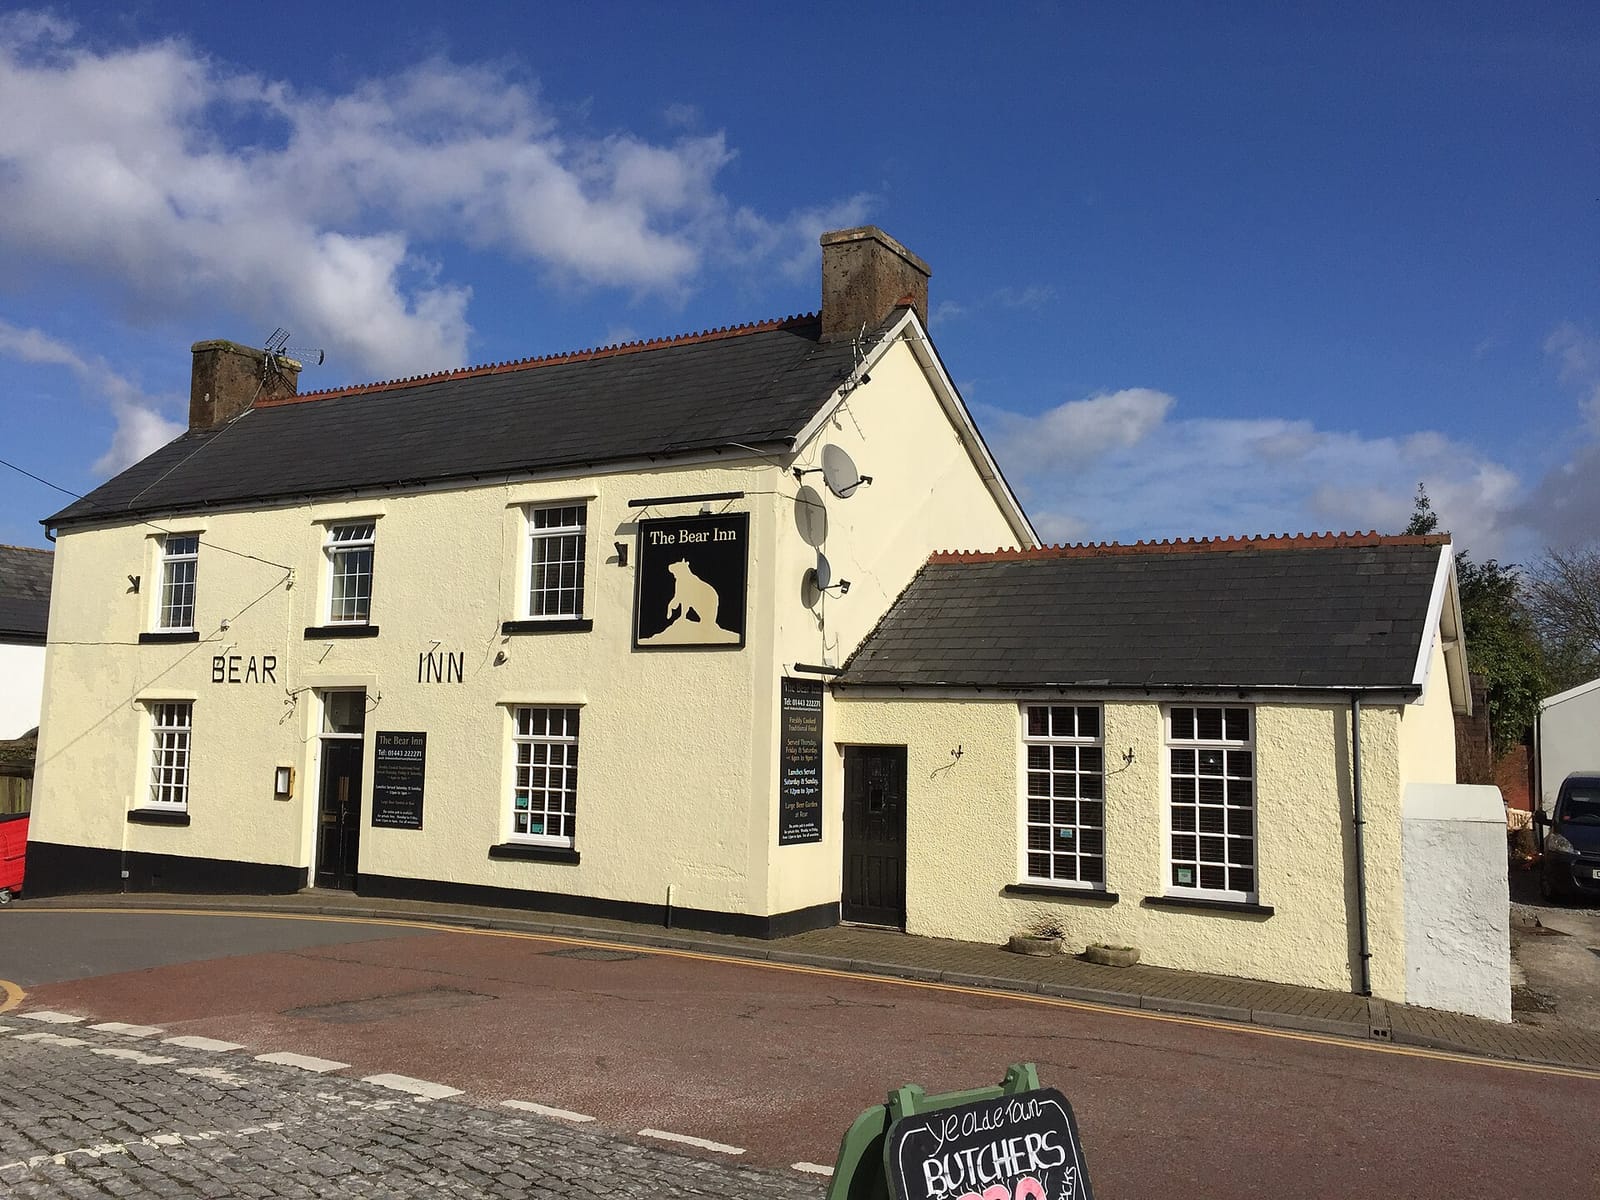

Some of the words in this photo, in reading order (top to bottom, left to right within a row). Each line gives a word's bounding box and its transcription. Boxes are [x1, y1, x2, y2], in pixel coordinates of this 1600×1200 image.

[649, 530, 675, 545] The
[678, 529, 710, 544] Bear
[712, 527, 737, 542] Inn
[212, 655, 277, 684] BEAR
[417, 651, 464, 684] INN
[379, 735, 392, 745] The
[393, 735, 409, 745] Bear
[411, 735, 423, 746] Inn
[387, 749, 403, 757] 01443
[923, 1130, 1066, 1197] BUTCHERS
